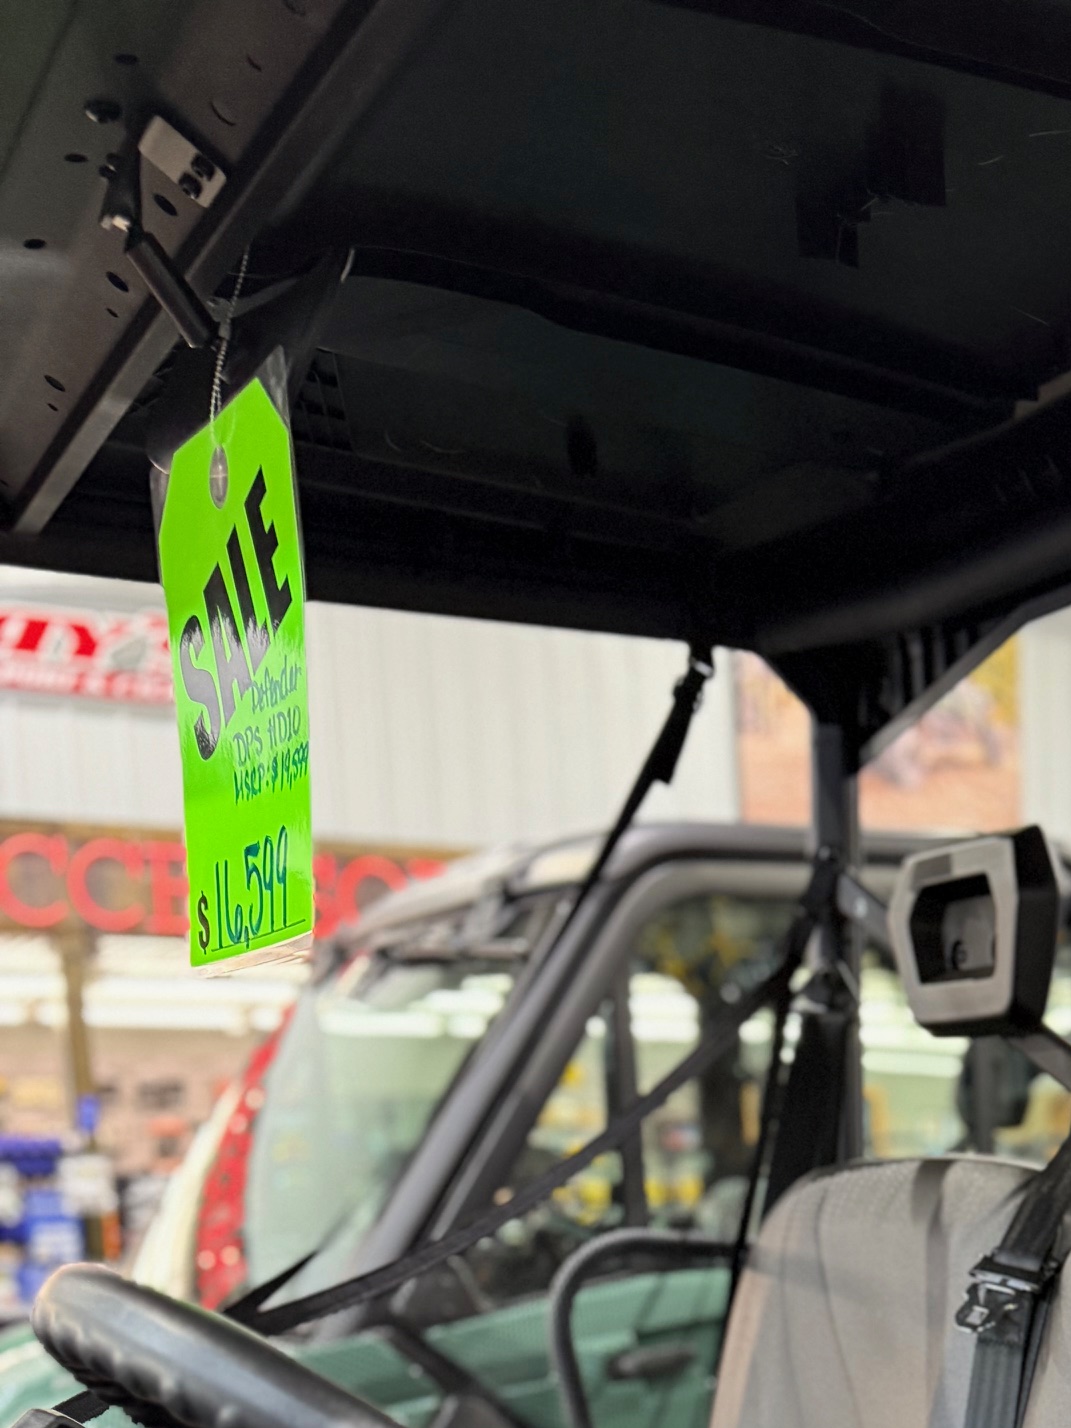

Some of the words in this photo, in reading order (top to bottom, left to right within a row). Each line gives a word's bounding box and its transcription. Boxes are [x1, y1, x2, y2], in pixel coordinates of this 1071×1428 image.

[179, 465, 293, 761] SALE
[251, 655, 302, 714] Defender
[233, 726, 263, 767] DPS
[267, 705, 301, 749] HD10
